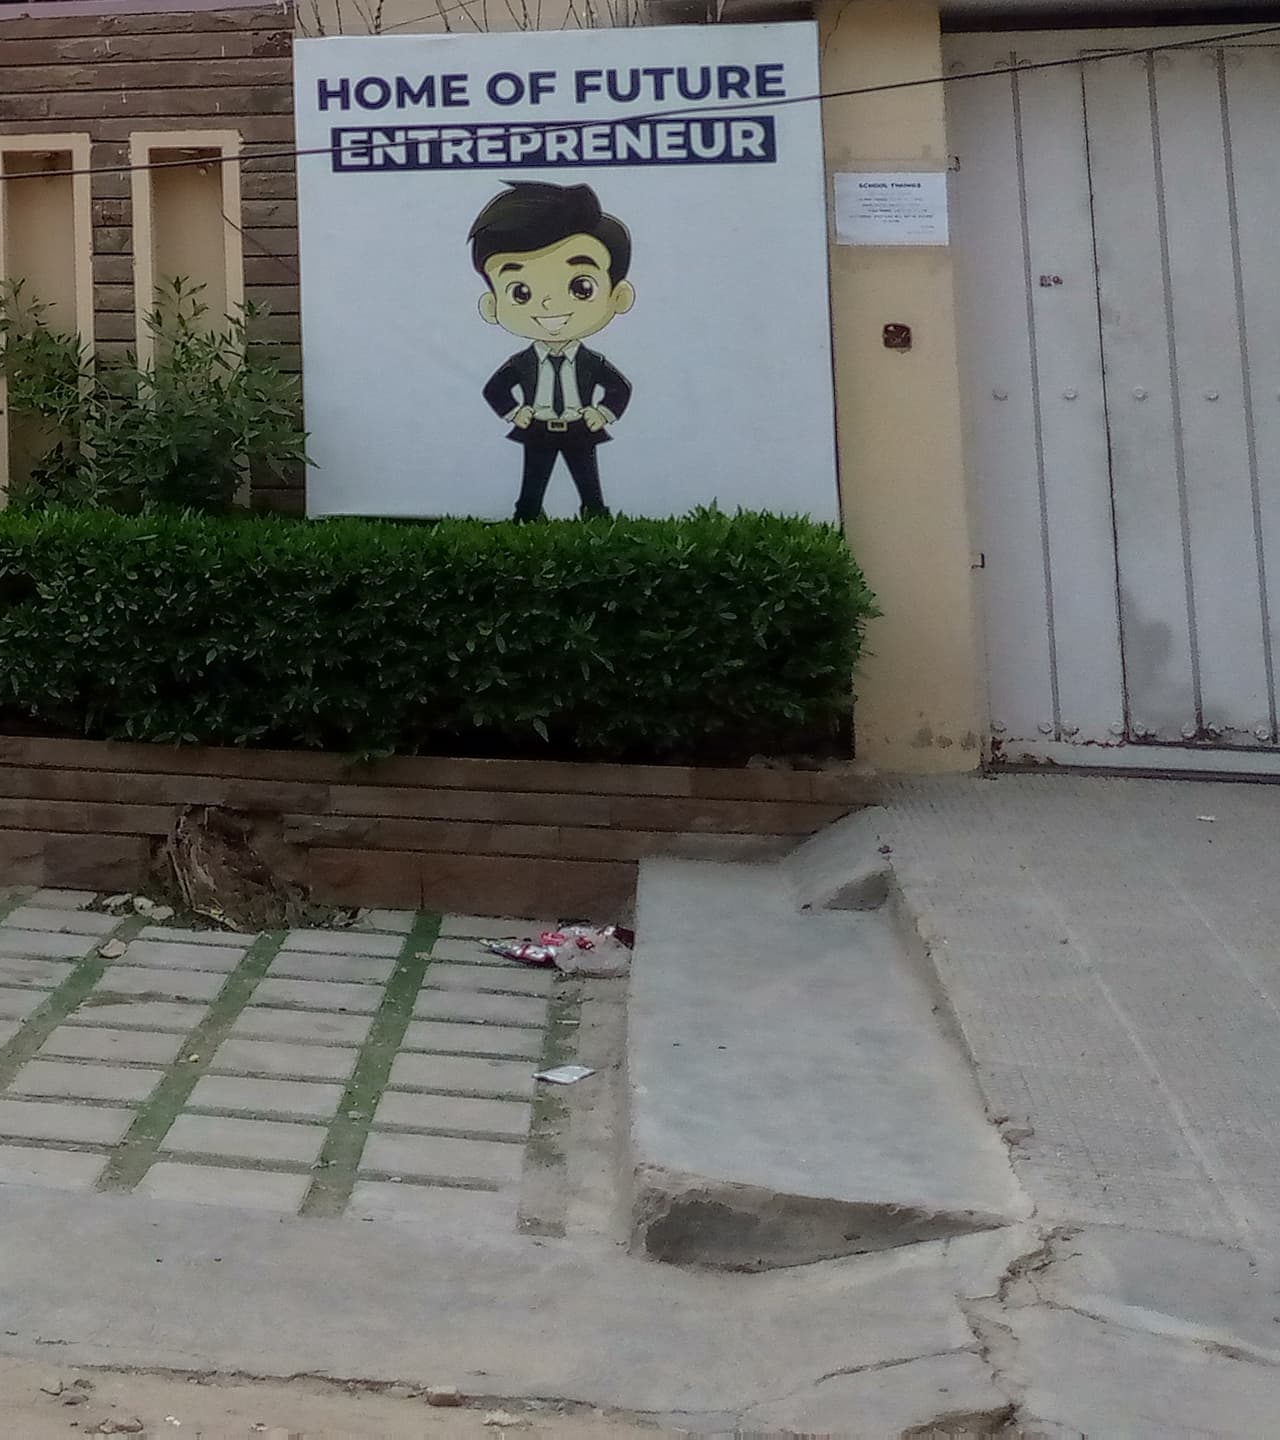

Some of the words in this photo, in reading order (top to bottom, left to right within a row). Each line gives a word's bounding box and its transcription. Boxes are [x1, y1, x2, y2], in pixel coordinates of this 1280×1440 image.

[317, 73, 470, 111] HOME
[486, 70, 557, 105] OF
[574, 63, 787, 103] FUTURE
[340, 121, 767, 167] ENTREPRENEUR
